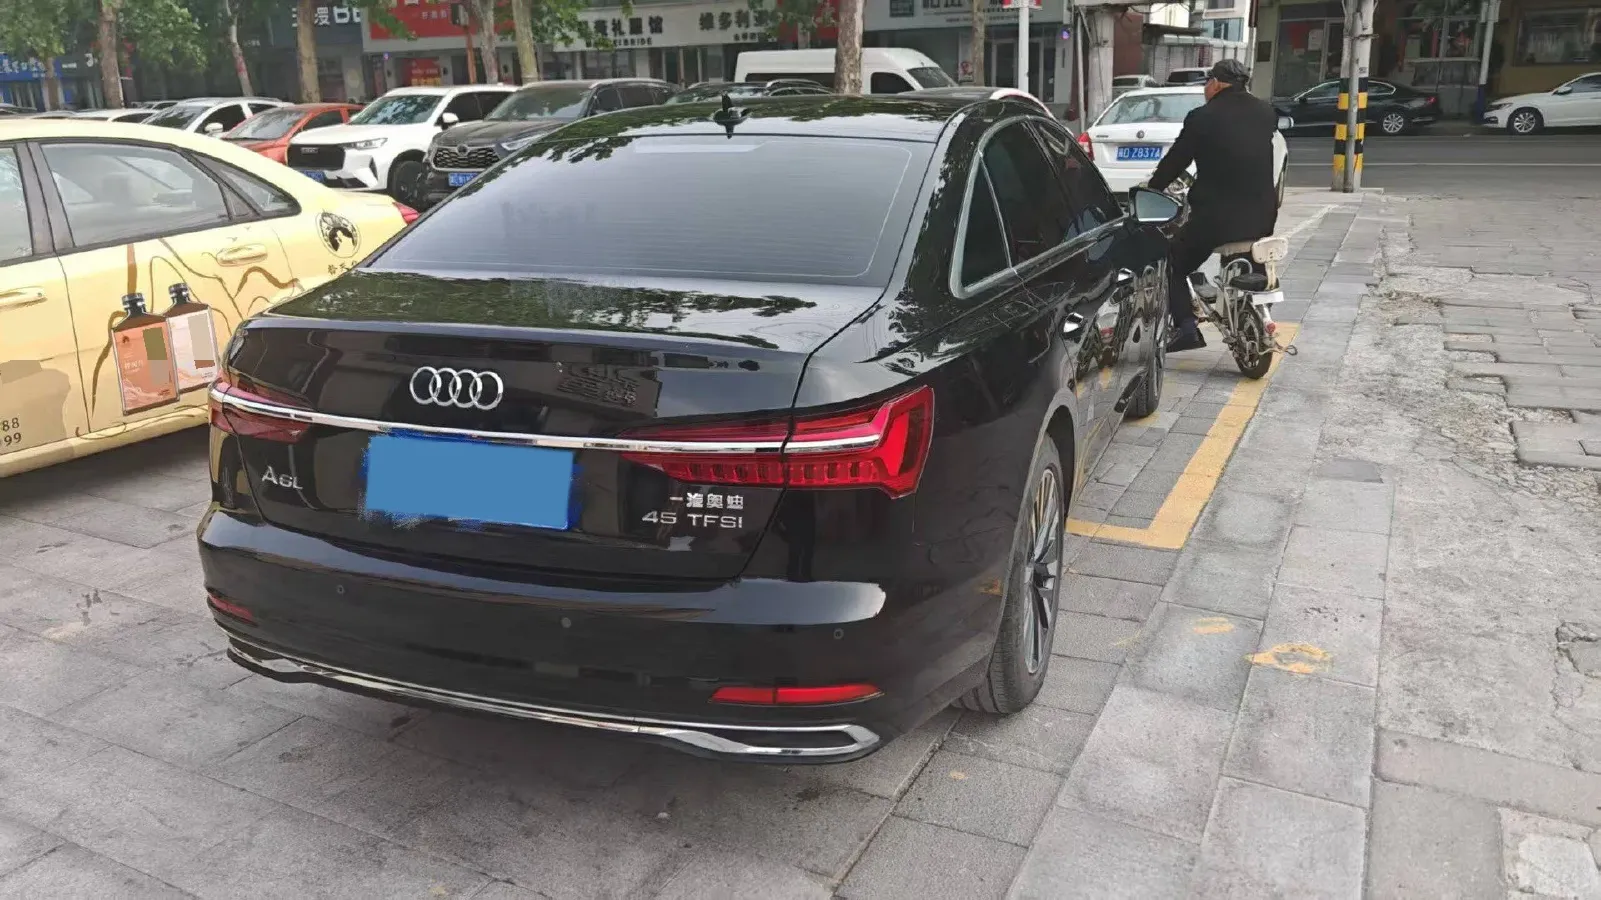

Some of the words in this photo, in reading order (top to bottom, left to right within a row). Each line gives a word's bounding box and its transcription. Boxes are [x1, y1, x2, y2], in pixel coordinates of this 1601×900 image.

[261, 465, 303, 490] A6L
[641, 510, 677, 524] 45
[687, 513, 743, 529] TFSI
